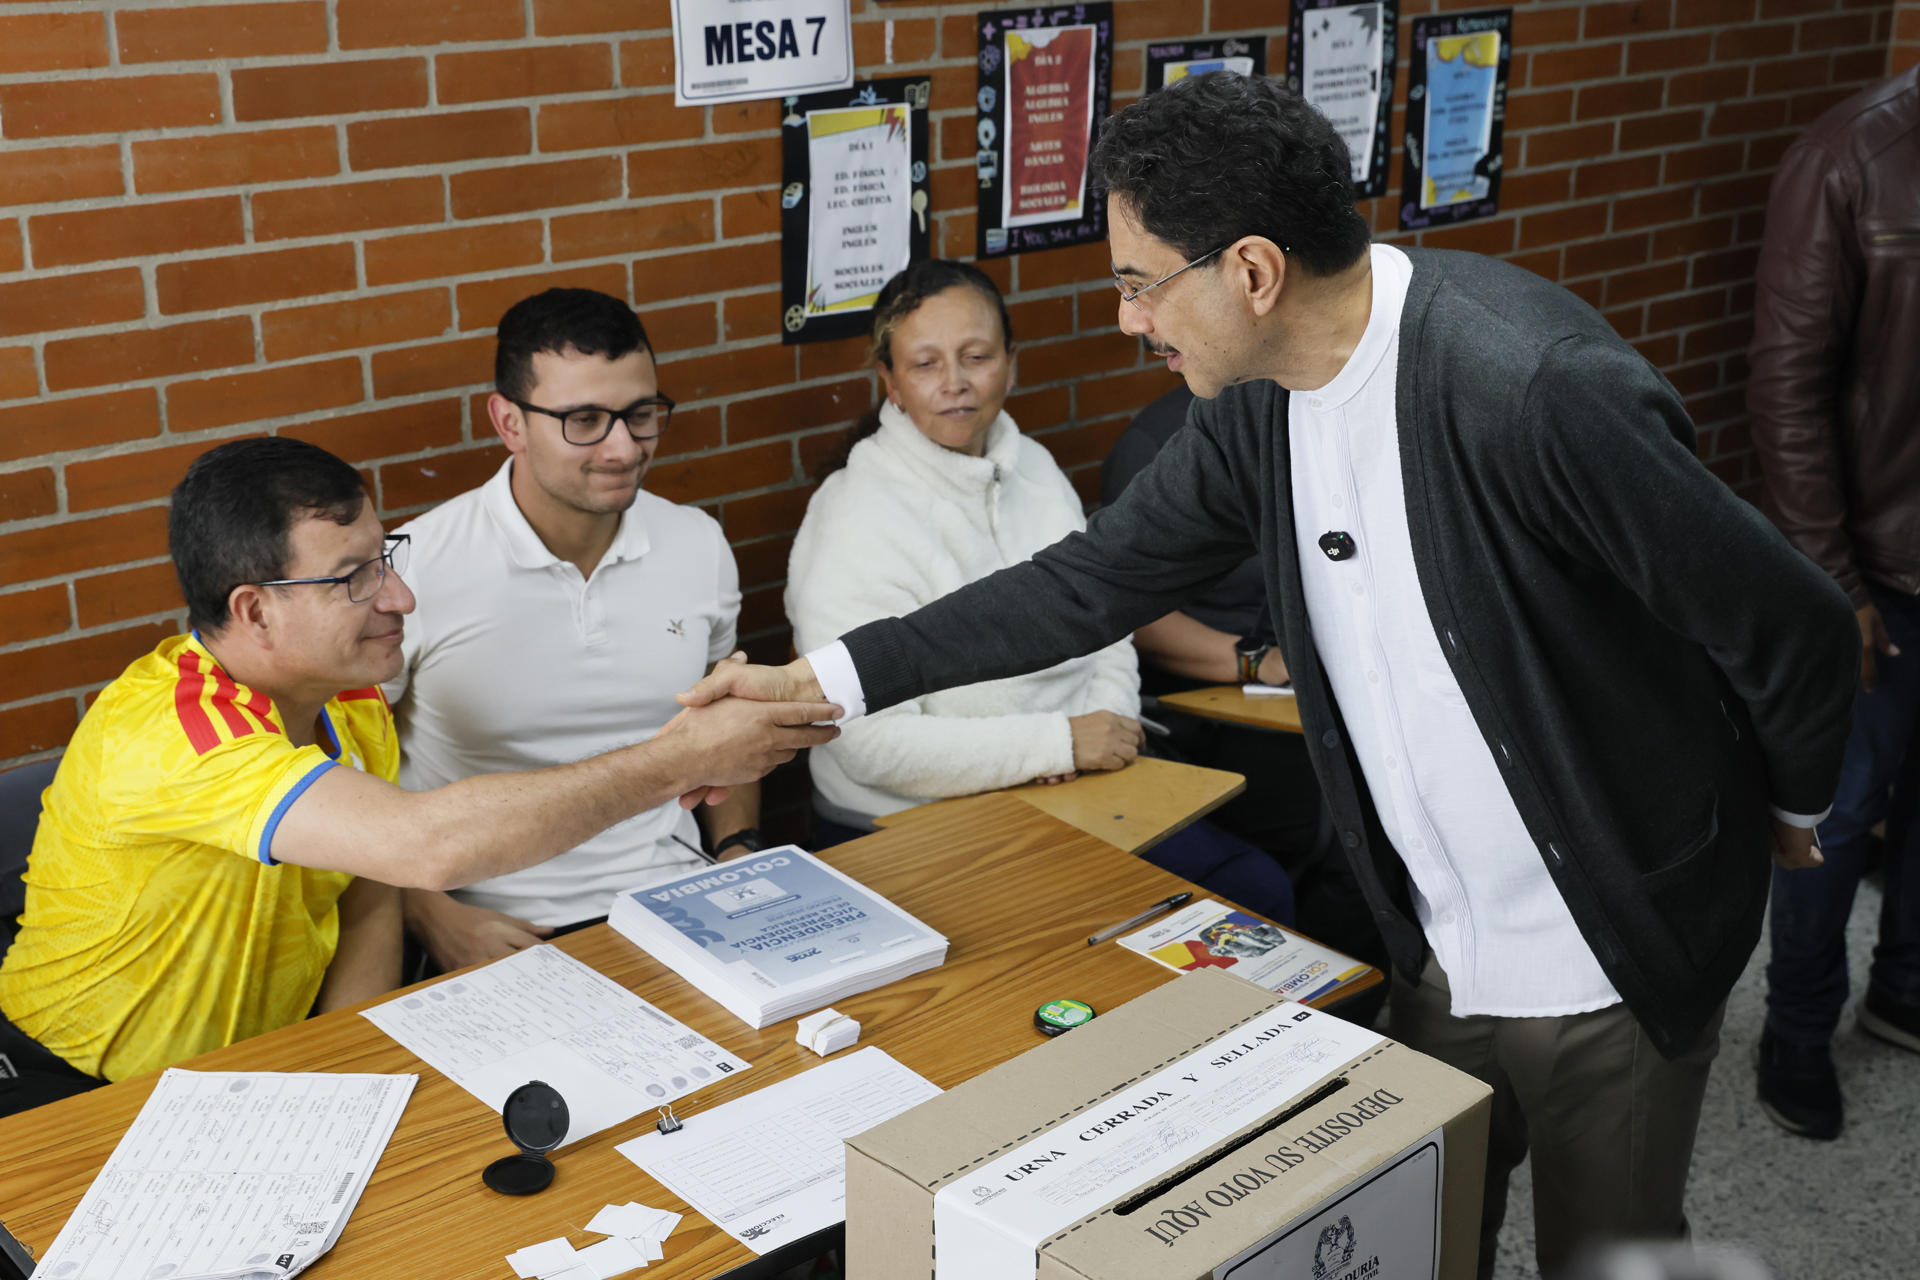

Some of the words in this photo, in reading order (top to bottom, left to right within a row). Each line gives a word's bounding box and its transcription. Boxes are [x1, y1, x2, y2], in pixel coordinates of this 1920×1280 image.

[704, 18, 800, 66] MESA
[805, 16, 826, 56] 7
[649, 856, 792, 902] COLOMBIA
[728, 905, 861, 948] VICEPRESIDENCIA
[748, 910, 869, 952] PRESIDENCIA
[1273, 961, 1329, 994] COLOMBIA
[1004, 1149, 1067, 1182] URNA
[1078, 1089, 1173, 1142] CERRADA
[1181, 1073, 1199, 1085] Y
[1210, 1023, 1293, 1069] SELLADA
[1293, 1088, 1404, 1154] DEPOSITE
[1264, 1146, 1305, 1174] SU
[1205, 1166, 1278, 1207] VOTO
[1144, 1199, 1212, 1248] AQUÍ
